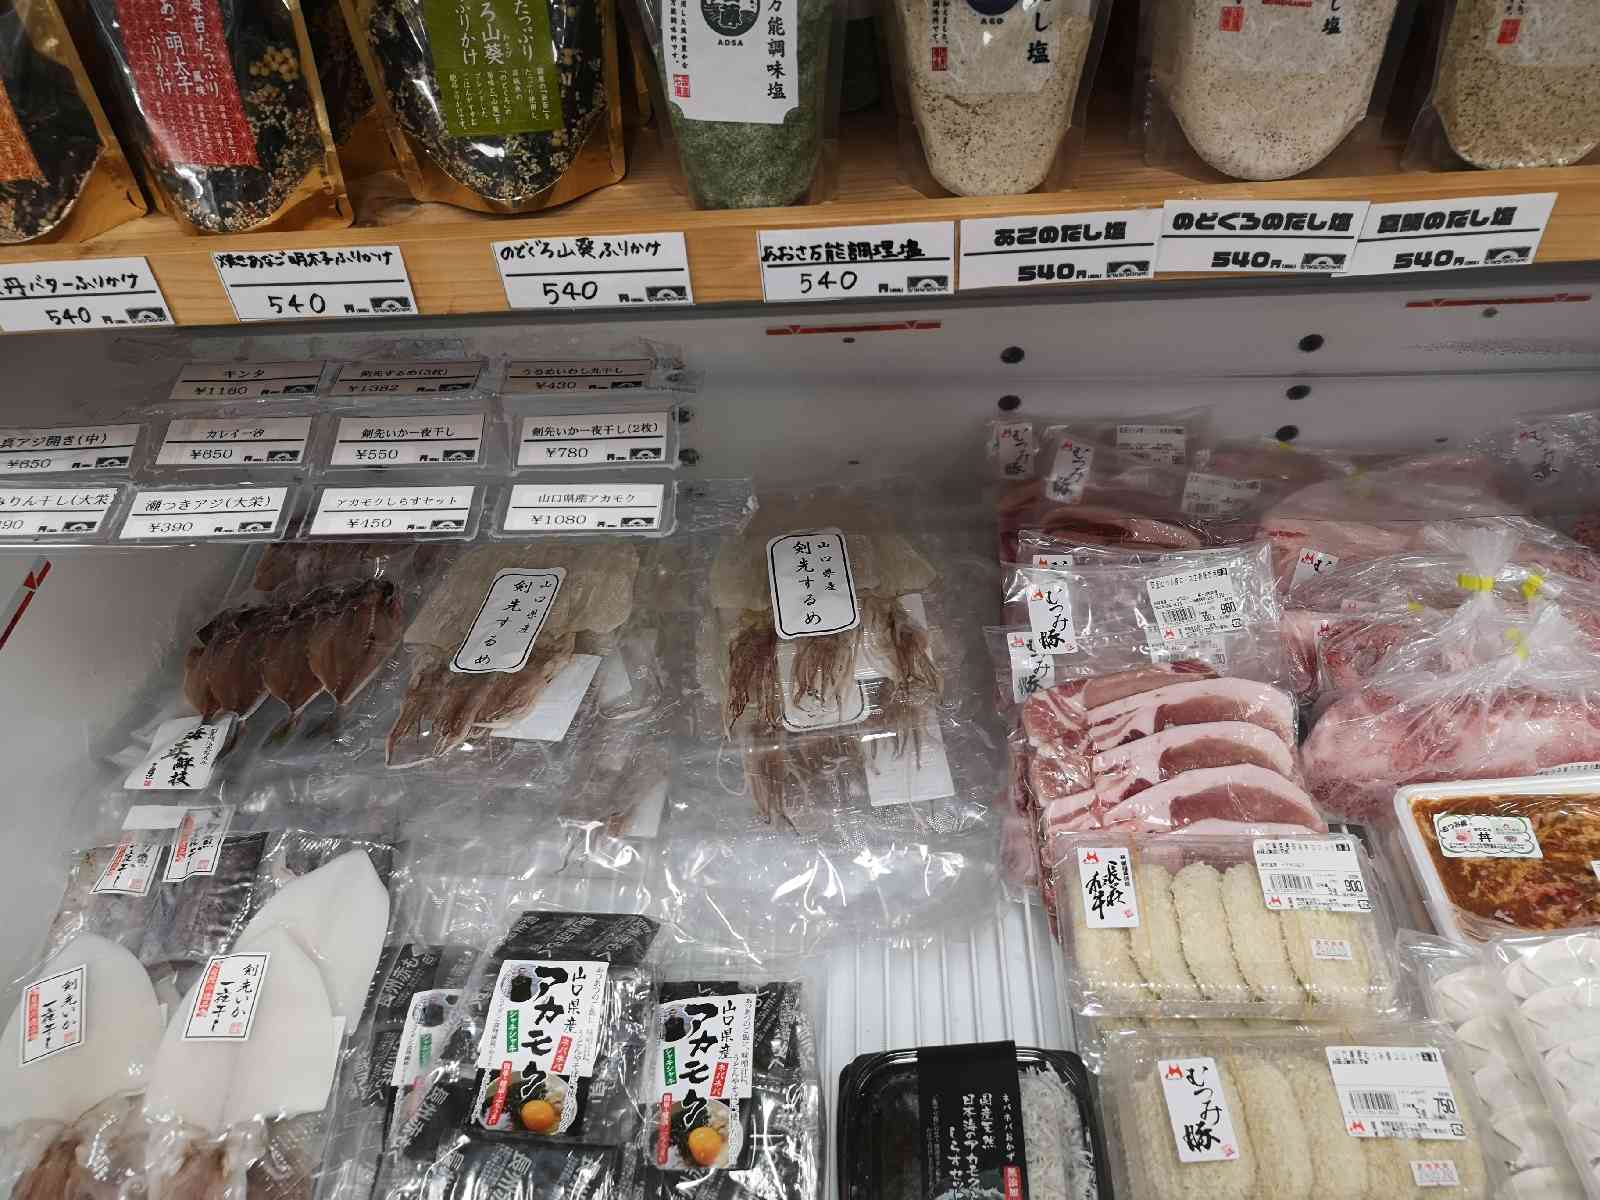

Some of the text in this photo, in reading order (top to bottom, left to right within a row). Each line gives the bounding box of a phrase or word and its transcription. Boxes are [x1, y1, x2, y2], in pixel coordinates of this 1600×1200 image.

[980, 17, 1004, 25] AGO
[767, 0, 787, 100] 万能調味塩
[0, 273, 139, 298] 丹バターふりかけ
[543, 281, 599, 305] 540
[799, 271, 858, 294] 540
[45, 306, 92, 326] 540
[268, 293, 327, 315] 540
[361, 427, 455, 439] 剣先いか一夜干し
[355, 449, 399, 460] ¥550
[545, 447, 589, 458] ¥780
[537, 493, 636, 504] 山口県産アカモク
[149, 521, 194, 533] ¥390
[529, 514, 587, 525] ¥1080
[817, 541, 839, 592] 山口県産
[793, 541, 823, 626] 剣先するめ
[474, 580, 533, 665] 剣先するめ
[1039, 588, 1069, 650] むつみ豚
[564, 965, 587, 1034] 山口県産
[521, 965, 569, 1104] アカモク
[719, 999, 737, 1060] 山口県産
[679, 1002, 719, 1128] アカモク
[1183, 1065, 1224, 1153] むつみ豚
[1433, 1097, 1457, 1115] 750
